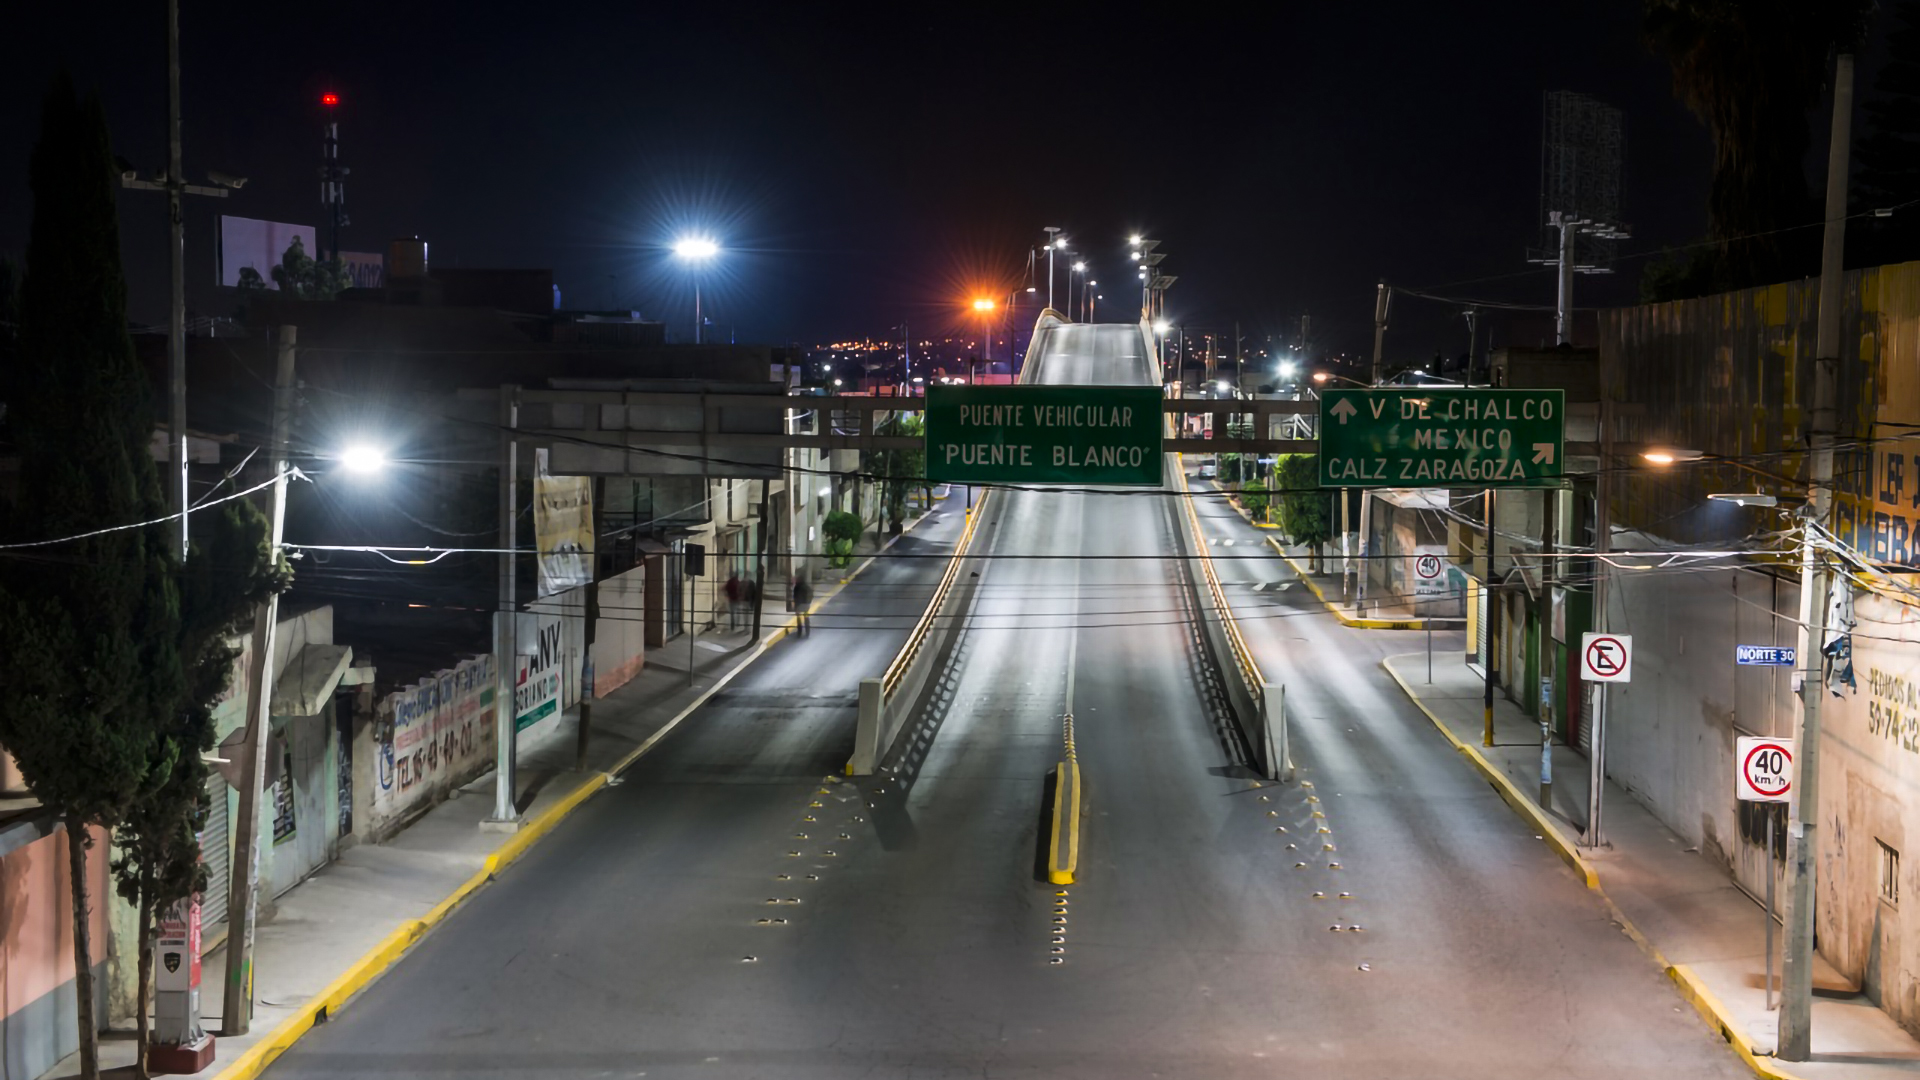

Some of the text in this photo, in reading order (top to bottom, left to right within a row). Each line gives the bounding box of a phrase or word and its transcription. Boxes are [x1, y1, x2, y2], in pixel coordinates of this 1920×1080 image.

[960, 404, 1133, 427] PUENTE VEHICULAR
[1369, 398, 1553, 420] V DE CHALCO
[1415, 428, 1512, 450] MEXICO
[1328, 457, 1526, 480] CALZ ZARAGOZA
[1421, 557, 1436, 569] 40
[1739, 648, 1794, 661] NORTE 30
[1869, 667, 1904, 704] PEDIDOS
[1755, 750, 1783, 775] 40
[1754, 774, 1786, 786] km/h
